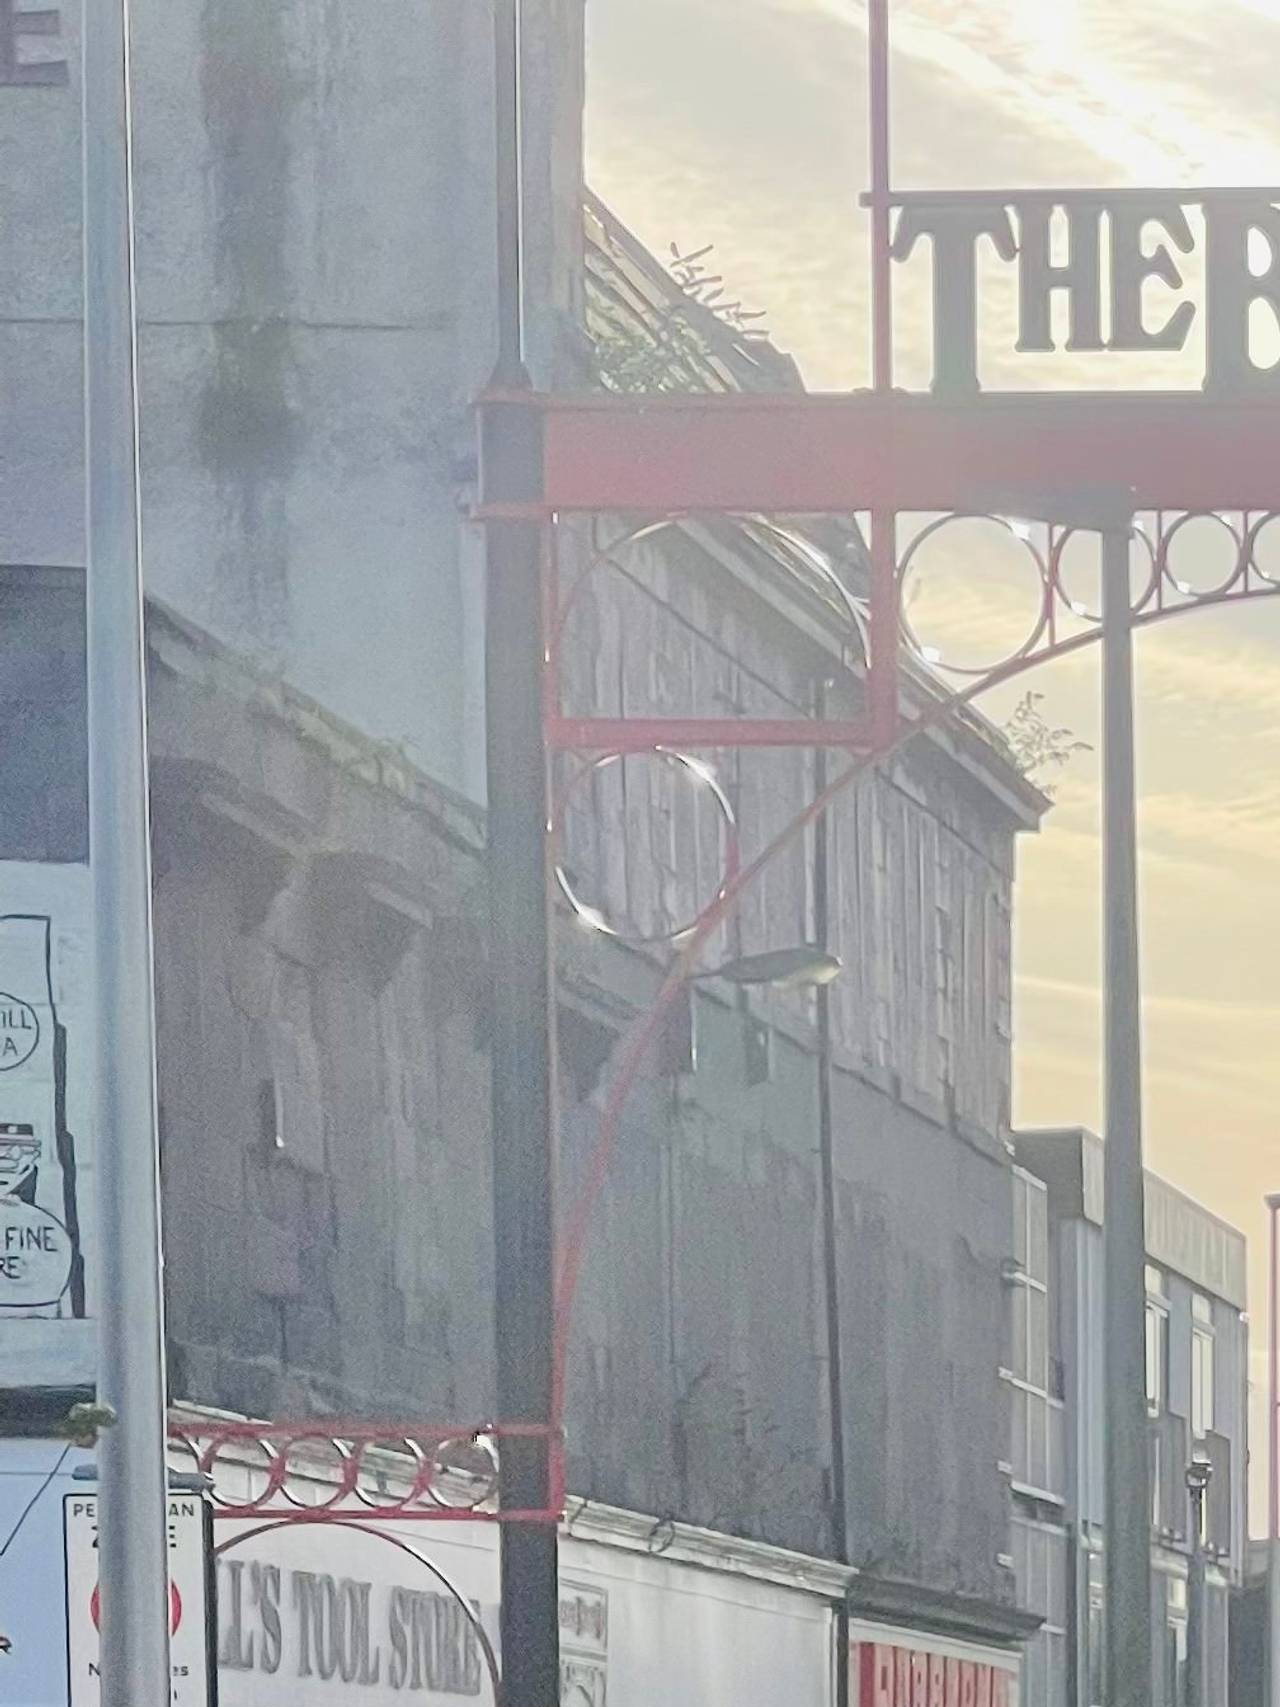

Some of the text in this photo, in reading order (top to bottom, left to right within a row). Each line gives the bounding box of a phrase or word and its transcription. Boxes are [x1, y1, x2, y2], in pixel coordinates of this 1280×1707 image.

[889, 203, 1196, 396] THE
[5, 1226, 58, 1252] FINE
[292, 1571, 380, 1688] TOOL
